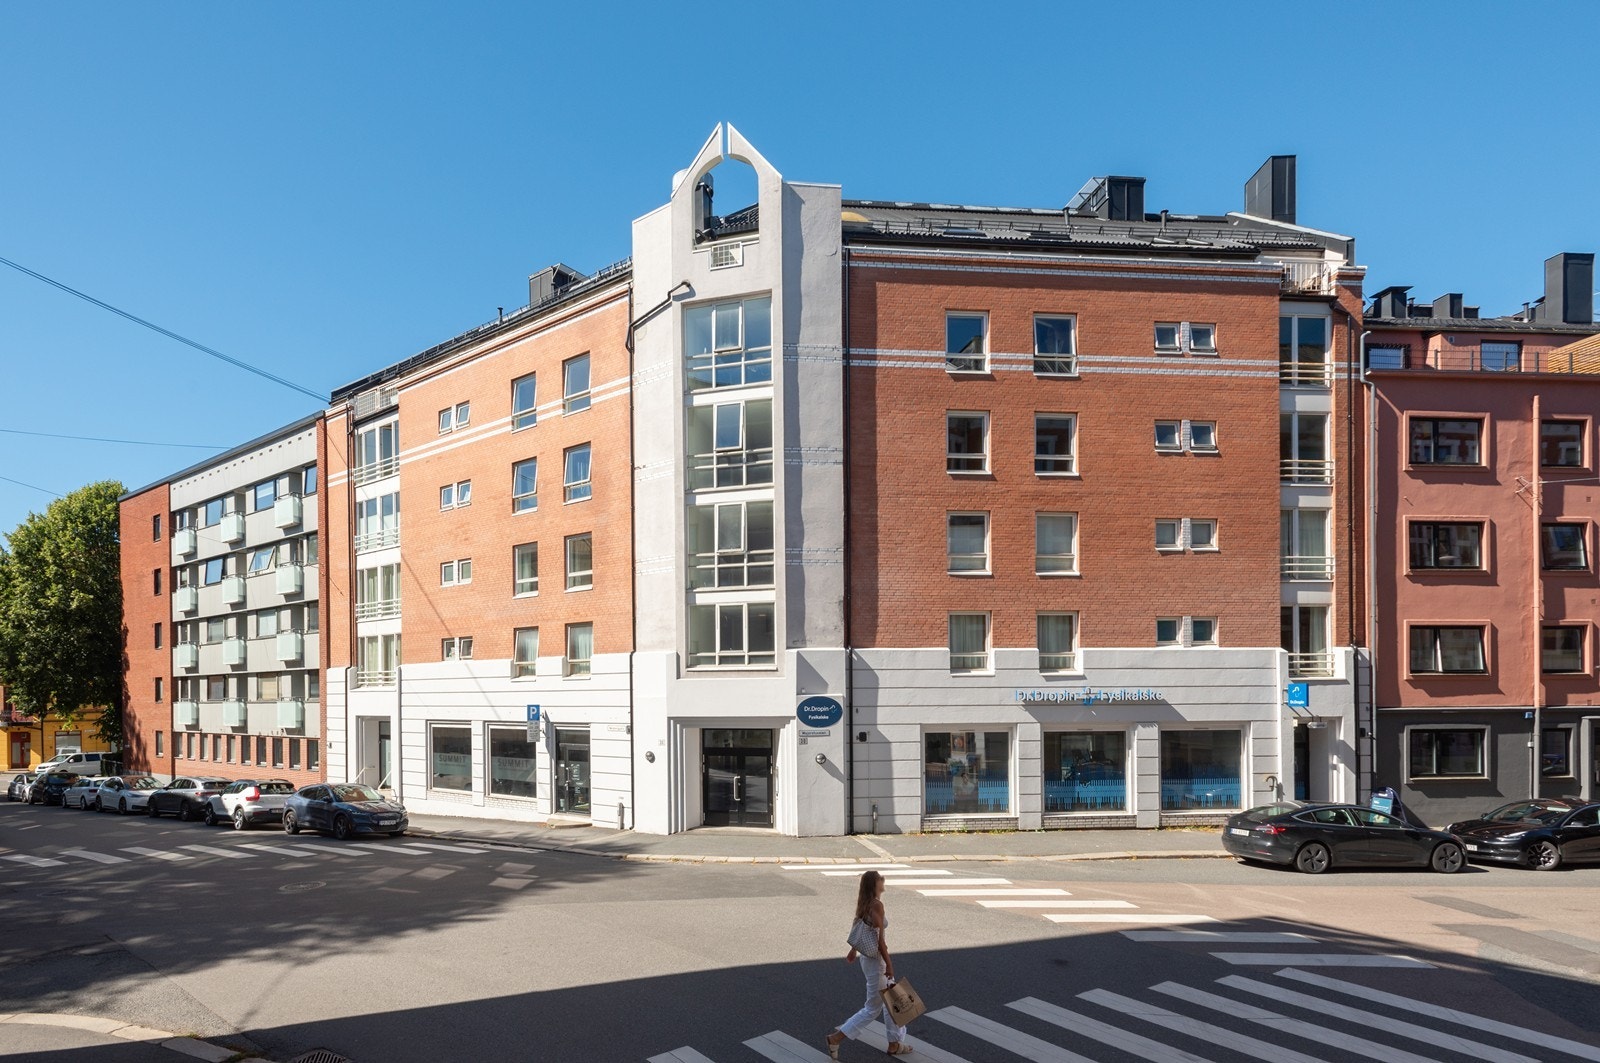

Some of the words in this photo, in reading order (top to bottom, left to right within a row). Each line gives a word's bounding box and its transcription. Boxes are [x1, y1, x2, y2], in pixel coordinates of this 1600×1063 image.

[1015, 689, 1077, 703] Dr.Dropin
[1098, 689, 1163, 703] Fysikalske
[529, 707, 537, 719] P
[438, 754, 466, 763] SUMMIT
[497, 758, 529, 768] SUMMIT
